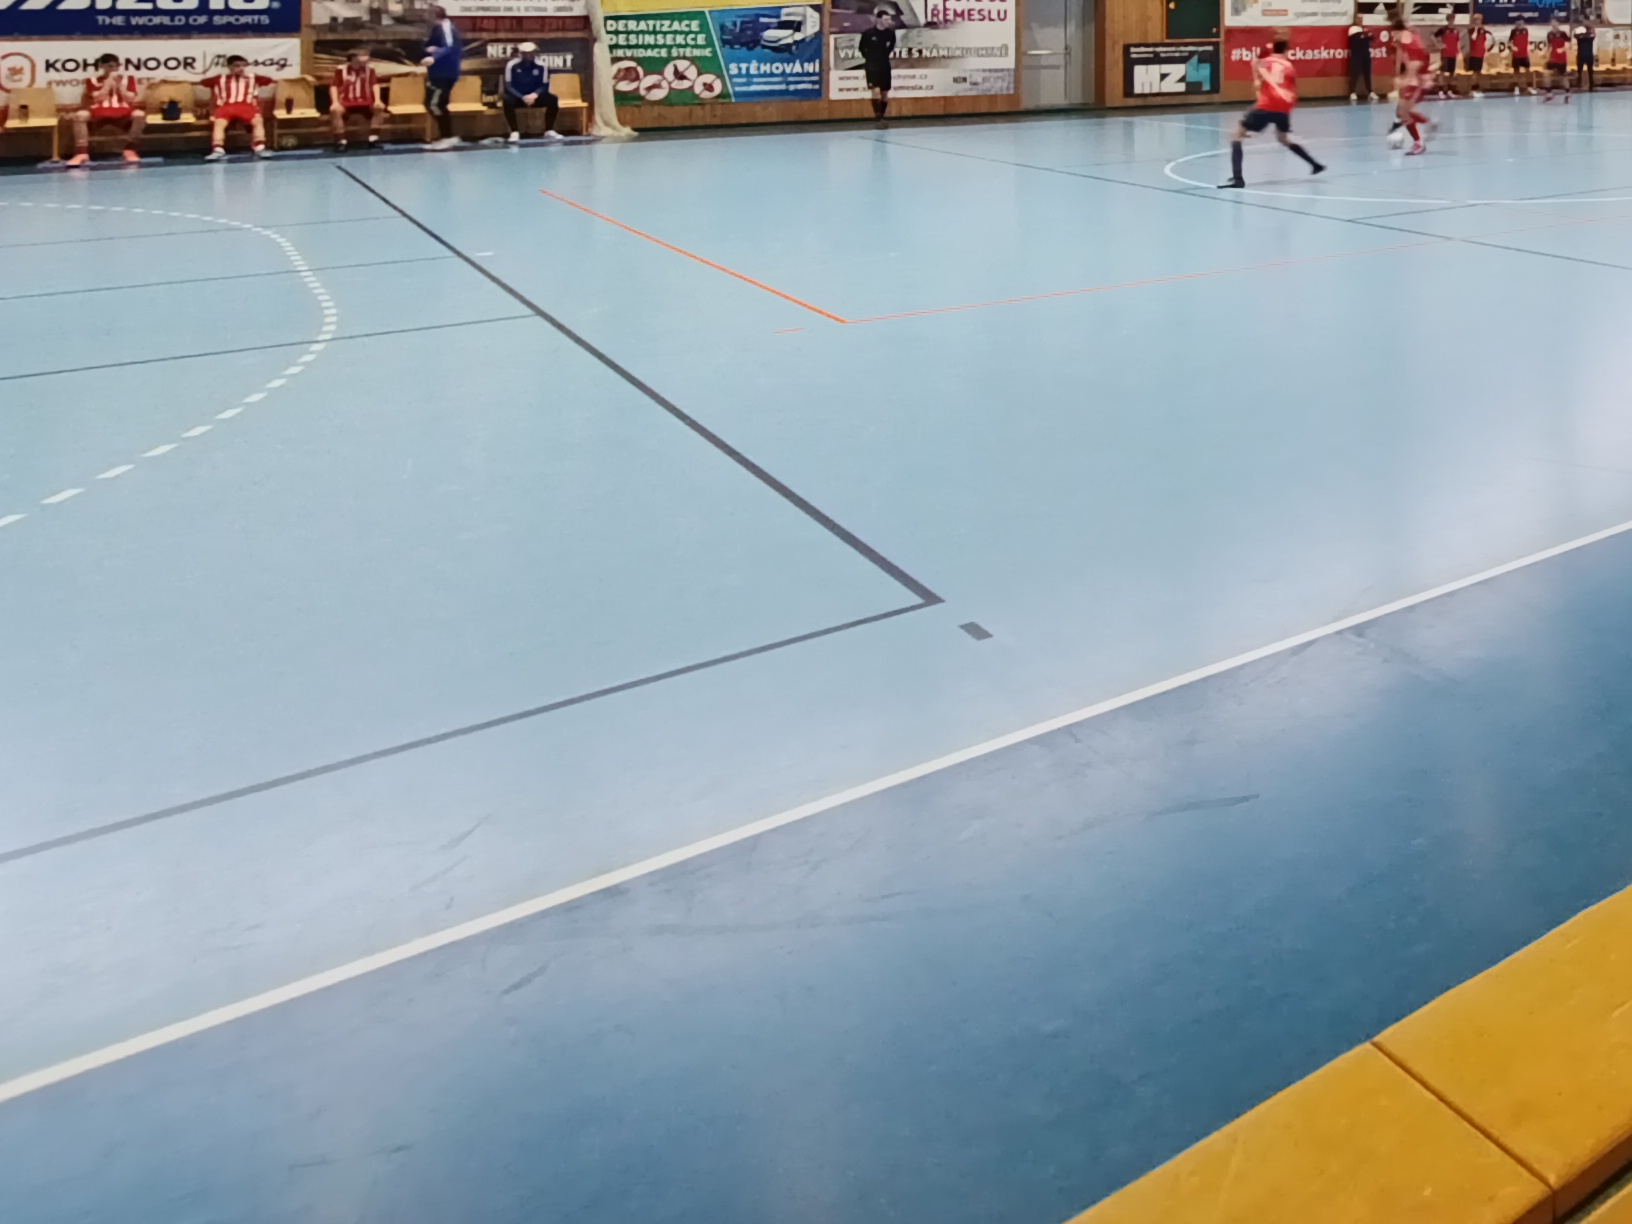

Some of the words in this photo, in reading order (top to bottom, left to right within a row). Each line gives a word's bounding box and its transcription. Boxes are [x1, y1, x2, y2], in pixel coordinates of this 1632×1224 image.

[96, 16, 126, 25] THE
[130, 16, 186, 25] WORLD
[189, 16, 209, 25] OF
[213, 15, 270, 25] SPORTS
[606, 19, 700, 32] DERATIZACE
[911, 48, 919, 58] S
[728, 59, 820, 75] STĚHOVÁNÍ
